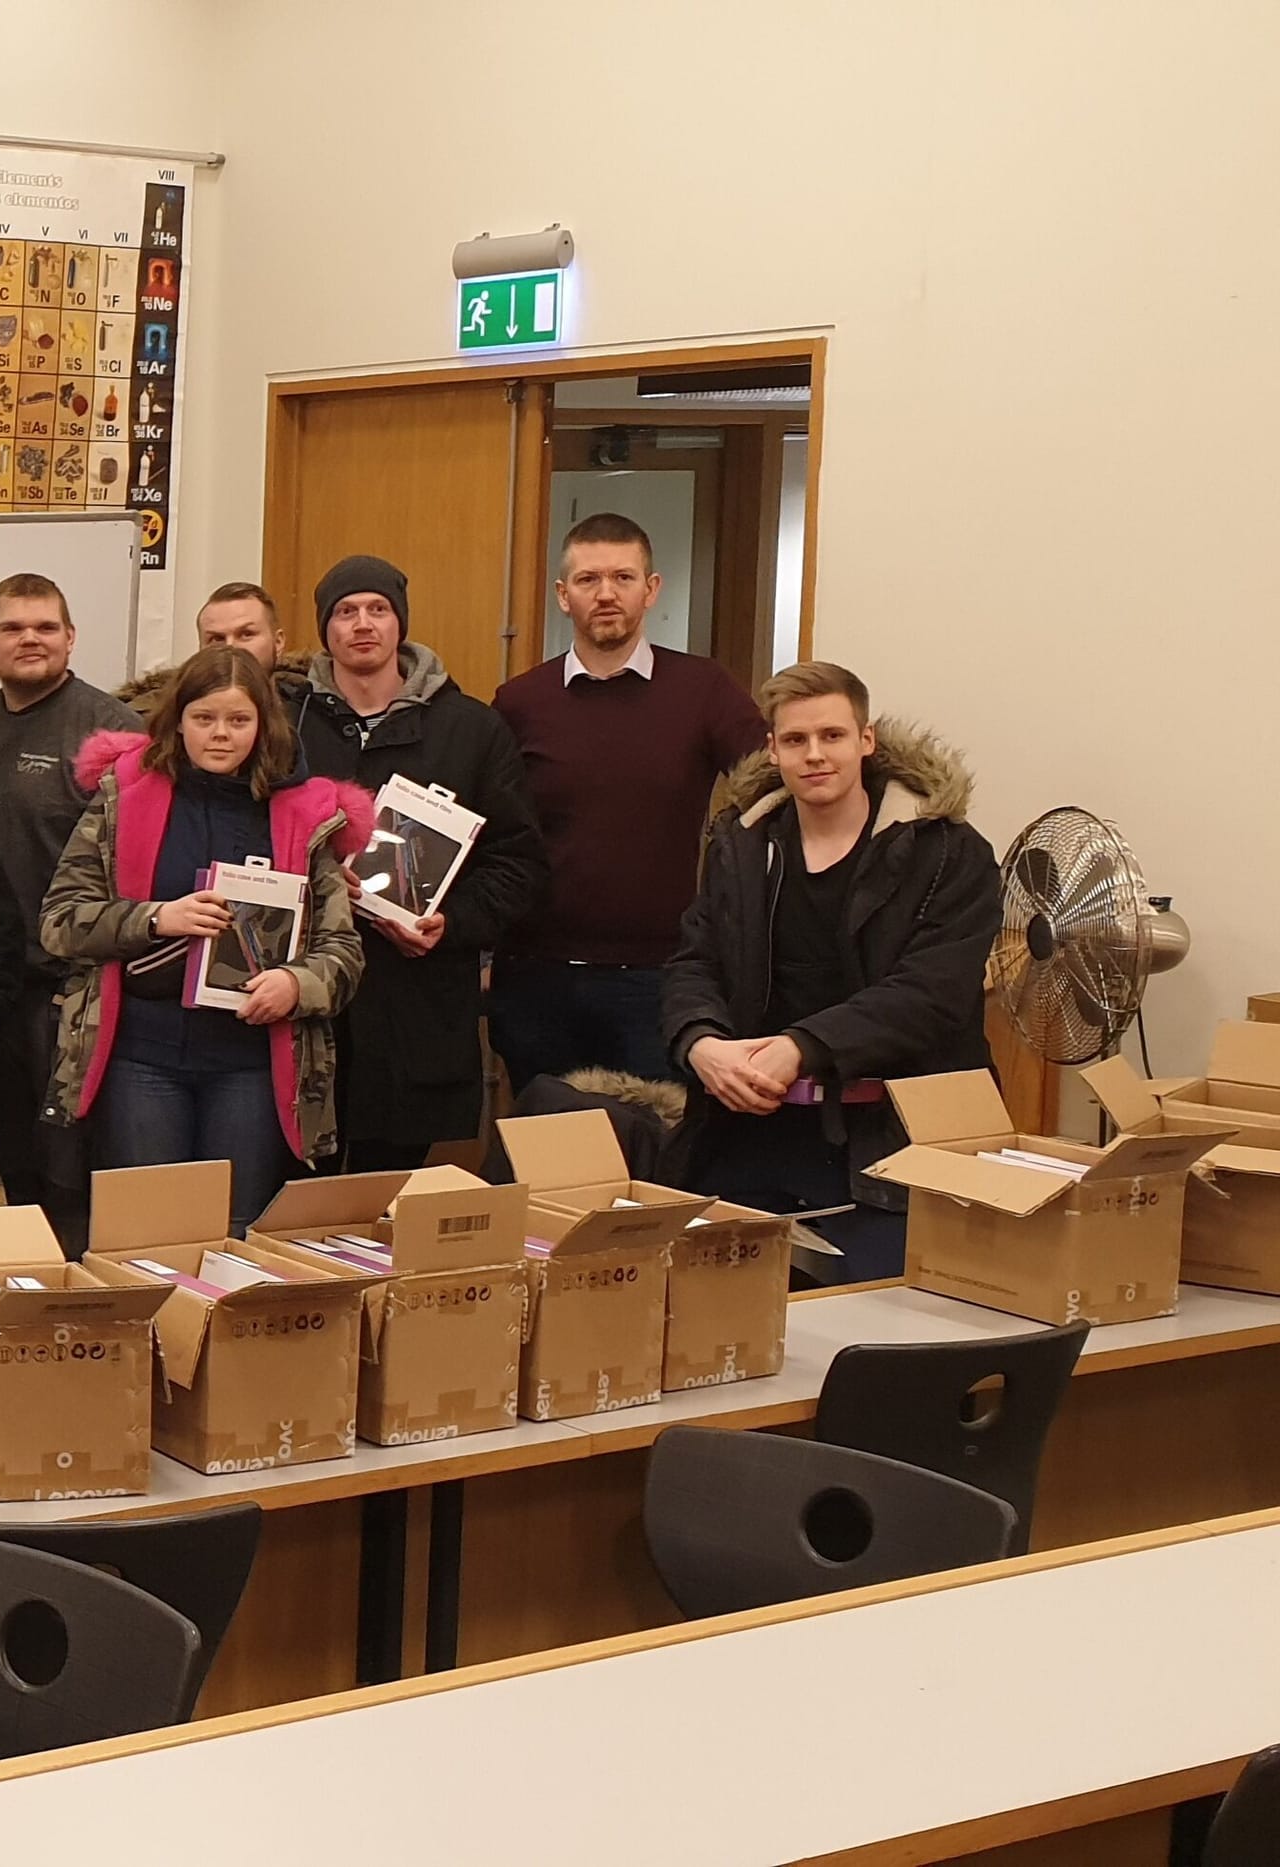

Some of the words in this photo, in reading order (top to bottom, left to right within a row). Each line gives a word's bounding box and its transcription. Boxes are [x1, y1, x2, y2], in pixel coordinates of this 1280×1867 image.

[158, 170, 175, 181] VIII
[4, 193, 80, 211] elementos
[42, 226, 50, 236] V
[78, 229, 89, 239] VI
[114, 232, 129, 243] VII
[159, 232, 177, 247] He
[0, 287, 10, 300] C
[40, 290, 51, 303] N
[76, 292, 86, 306] O
[112, 295, 121, 307] F
[153, 297, 173, 312] Ne
[36, 355, 46, 369] P
[73, 357, 83, 371] S
[108, 360, 122, 373] Cl
[148, 361, 167, 375] Ar
[31, 422, 48, 436] As
[68, 423, 84, 437] Se
[105, 424, 120, 438] Br
[146, 425, 165, 440] Kr
[28, 485, 44, 499] Sb
[65, 487, 77, 500] Te
[143, 487, 163, 502] Xe
[140, 550, 160, 566] Rn
